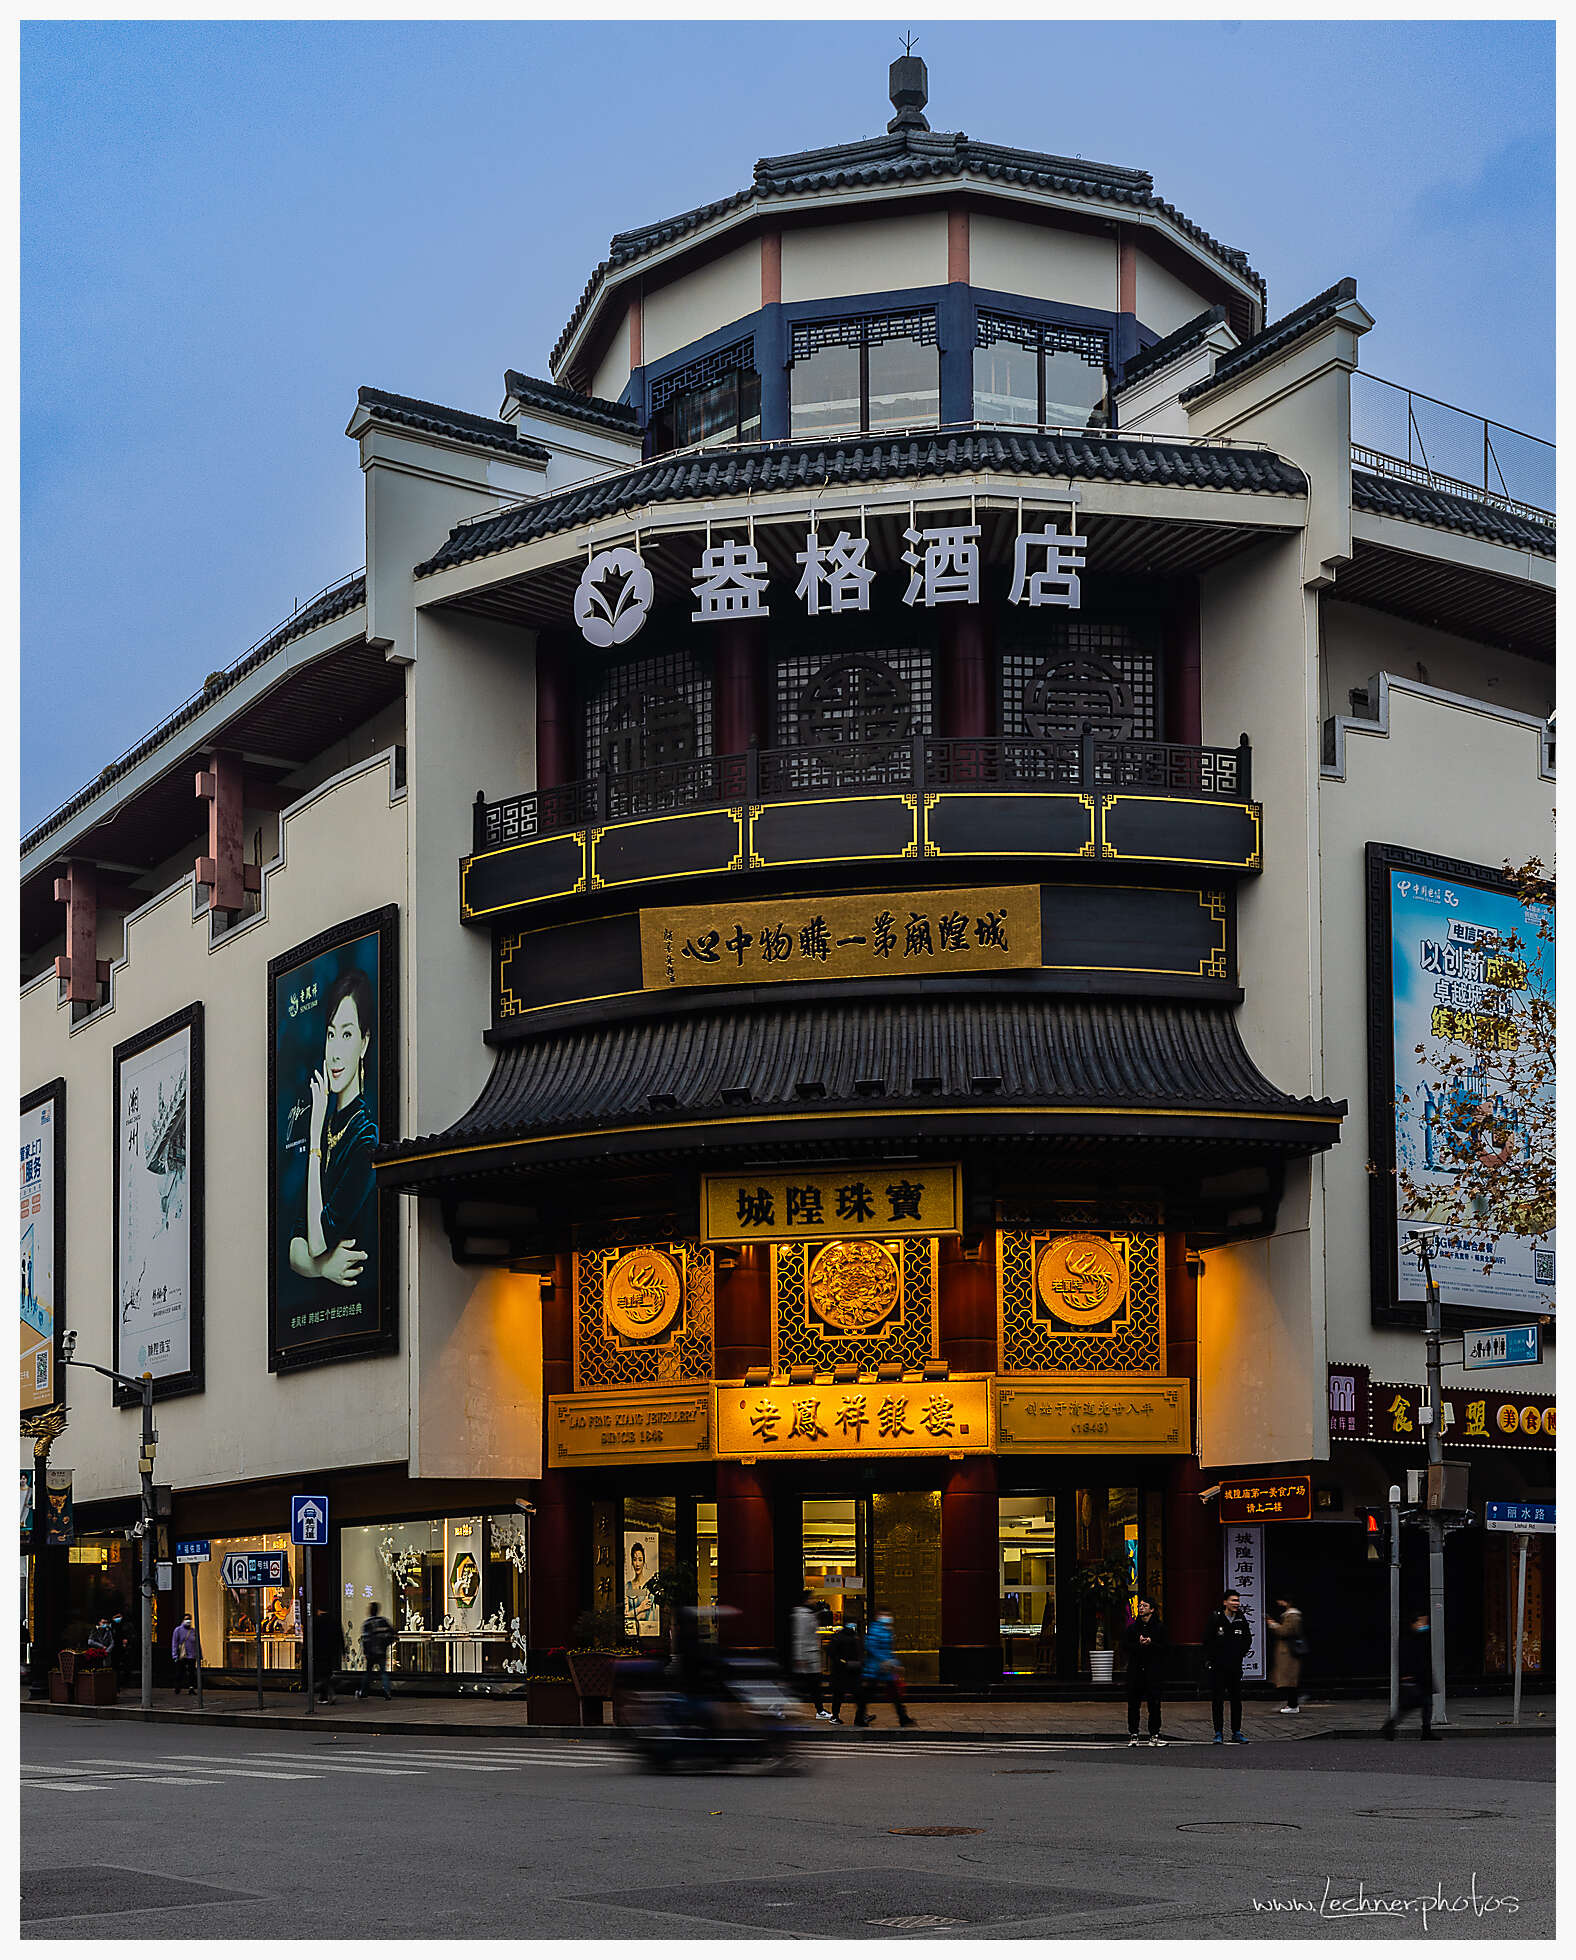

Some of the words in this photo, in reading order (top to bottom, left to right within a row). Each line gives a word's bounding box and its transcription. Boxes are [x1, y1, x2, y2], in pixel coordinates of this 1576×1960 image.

[691, 524, 1088, 622] 盎格酒店
[736, 1179, 925, 1228] 城隍珠寶
[750, 1394, 956, 1443] 老鳳祥銀樓
[1387, 1394, 1490, 1438] 食盟
[1224, 1485, 1306, 1500] 城隍庙第一美食广场
[1246, 1501, 1283, 1514] 请上二楼
[304, 1518, 316, 1539] 单行道
[1507, 1506, 1545, 1520] 丽水路
